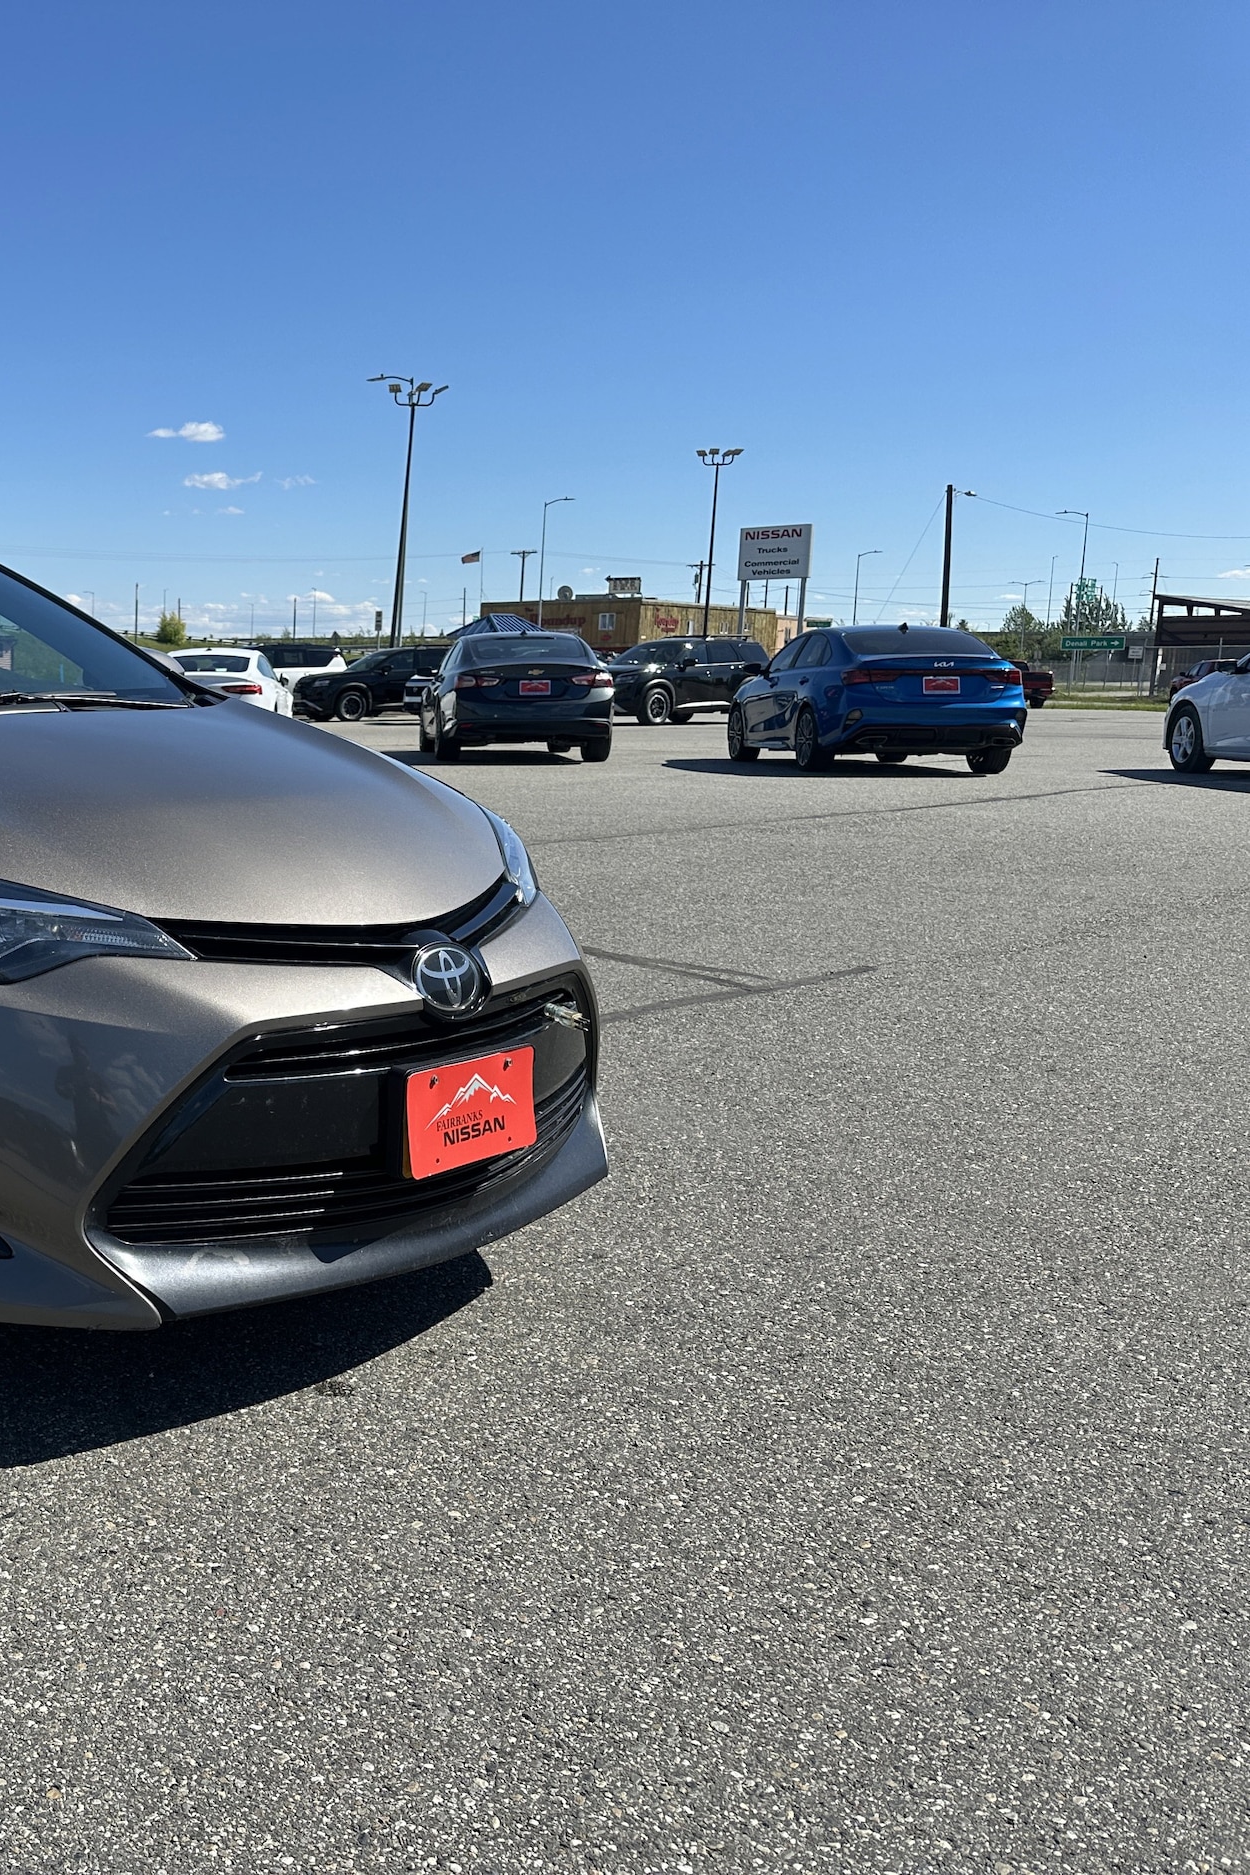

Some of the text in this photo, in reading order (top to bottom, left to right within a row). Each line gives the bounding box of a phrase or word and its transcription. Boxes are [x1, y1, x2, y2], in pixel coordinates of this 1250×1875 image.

[745, 528, 802, 540] NISSAN
[757, 546, 788, 554] Trucks
[744, 558, 800, 568] Commercial
[751, 568, 791, 576] Vehicles
[436, 1110, 483, 1132] FAIRBANKS
[443, 1115, 505, 1147] NISSAN
